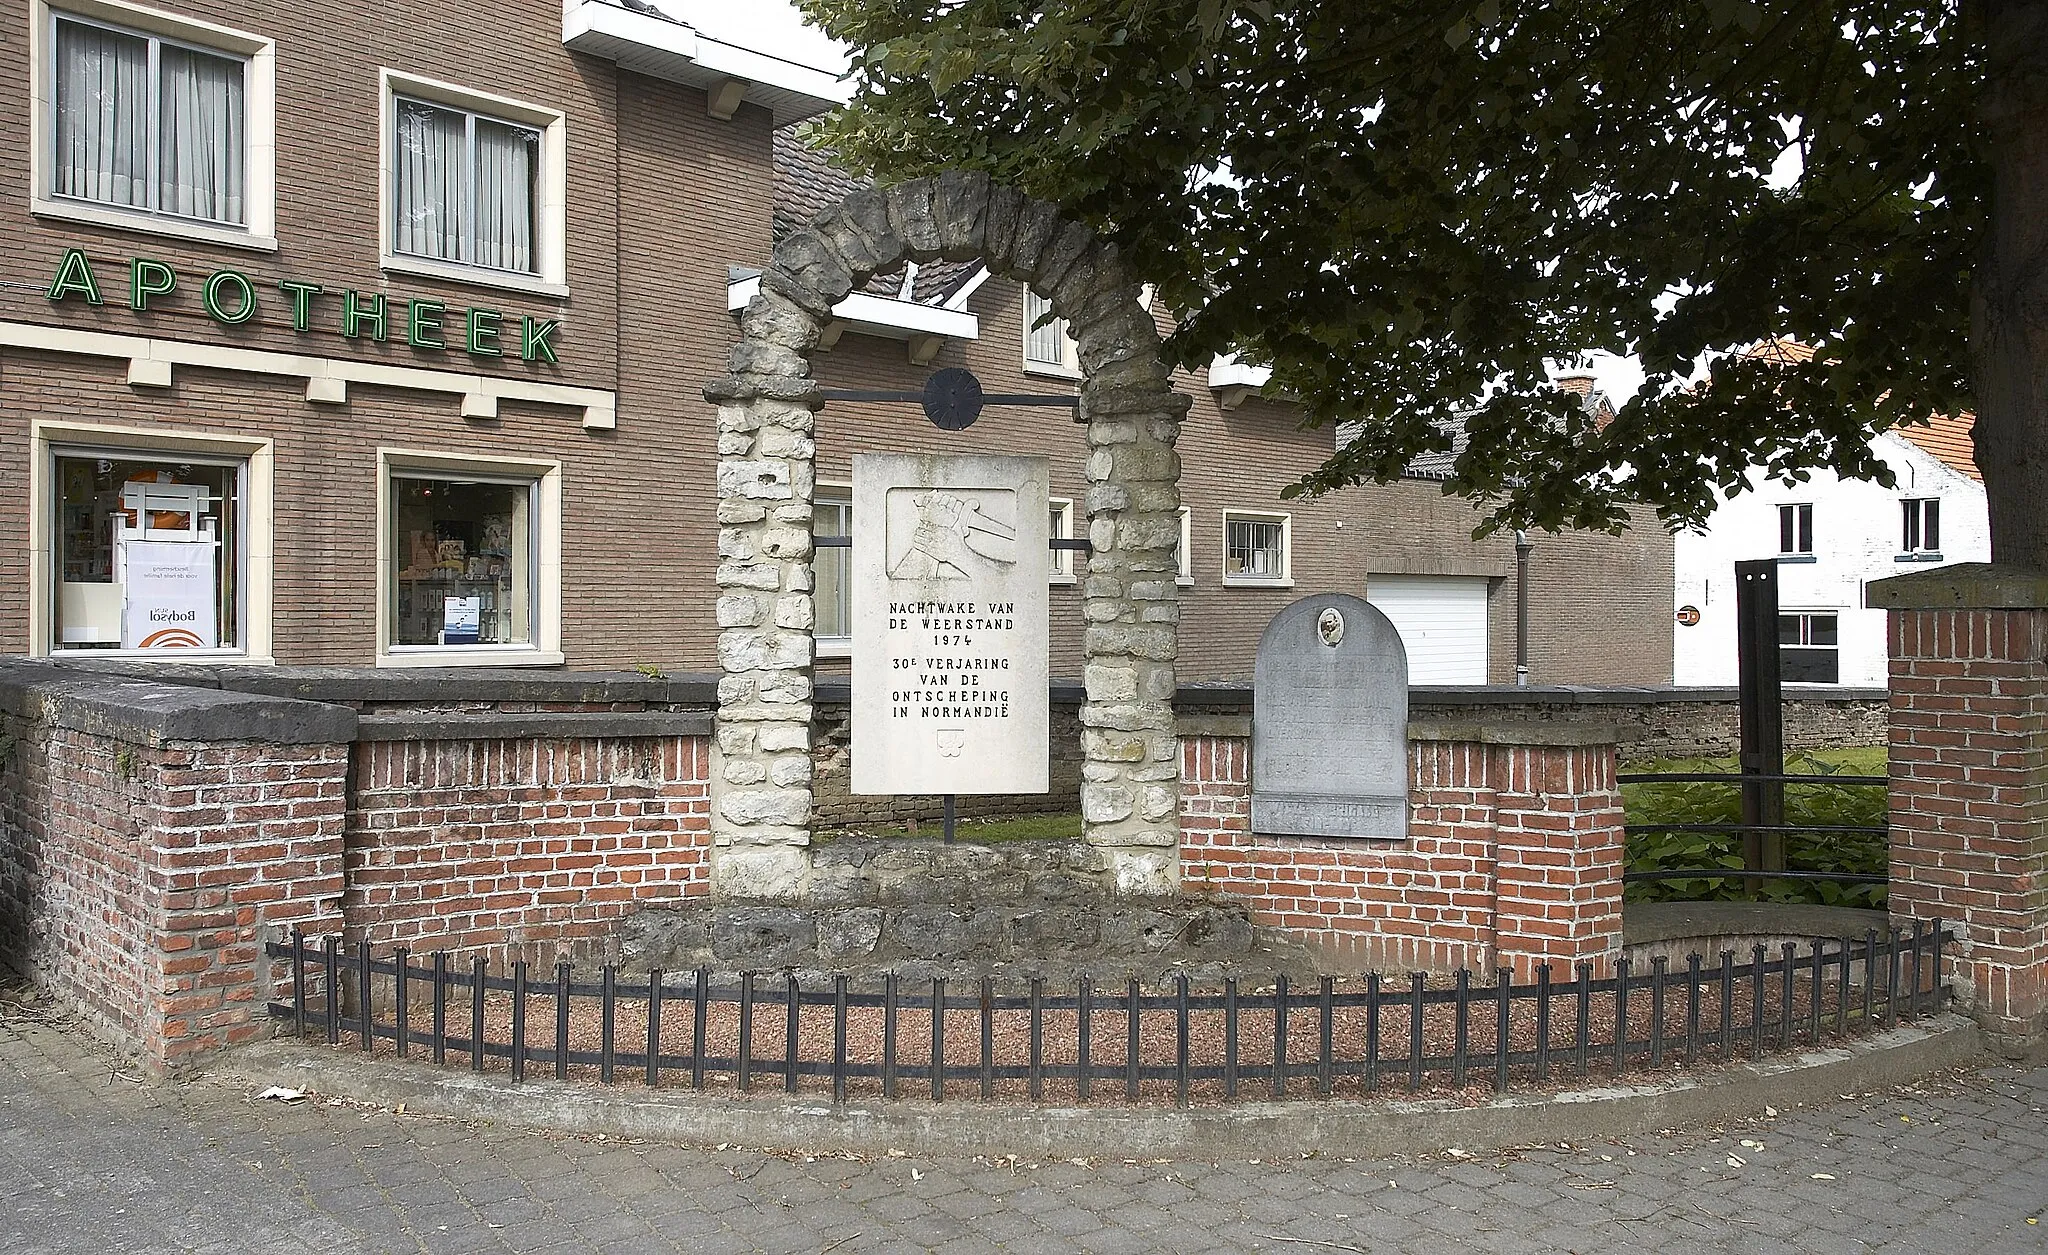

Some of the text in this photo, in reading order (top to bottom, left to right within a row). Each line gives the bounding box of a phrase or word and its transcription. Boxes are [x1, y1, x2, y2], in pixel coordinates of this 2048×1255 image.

[46, 247, 560, 364] APOTHEEK
[889, 602, 1014, 614] NACHTWAKE VAN
[889, 618, 1014, 630] DE WEERSTAND
[933, 635, 972, 646] 1974
[926, 658, 1009, 670] VERJARING
[920, 674, 979, 686] VAN DE
[892, 690, 1009, 703] ONTSCHEPING
[893, 702, 1010, 718] IN NORMANDIË
